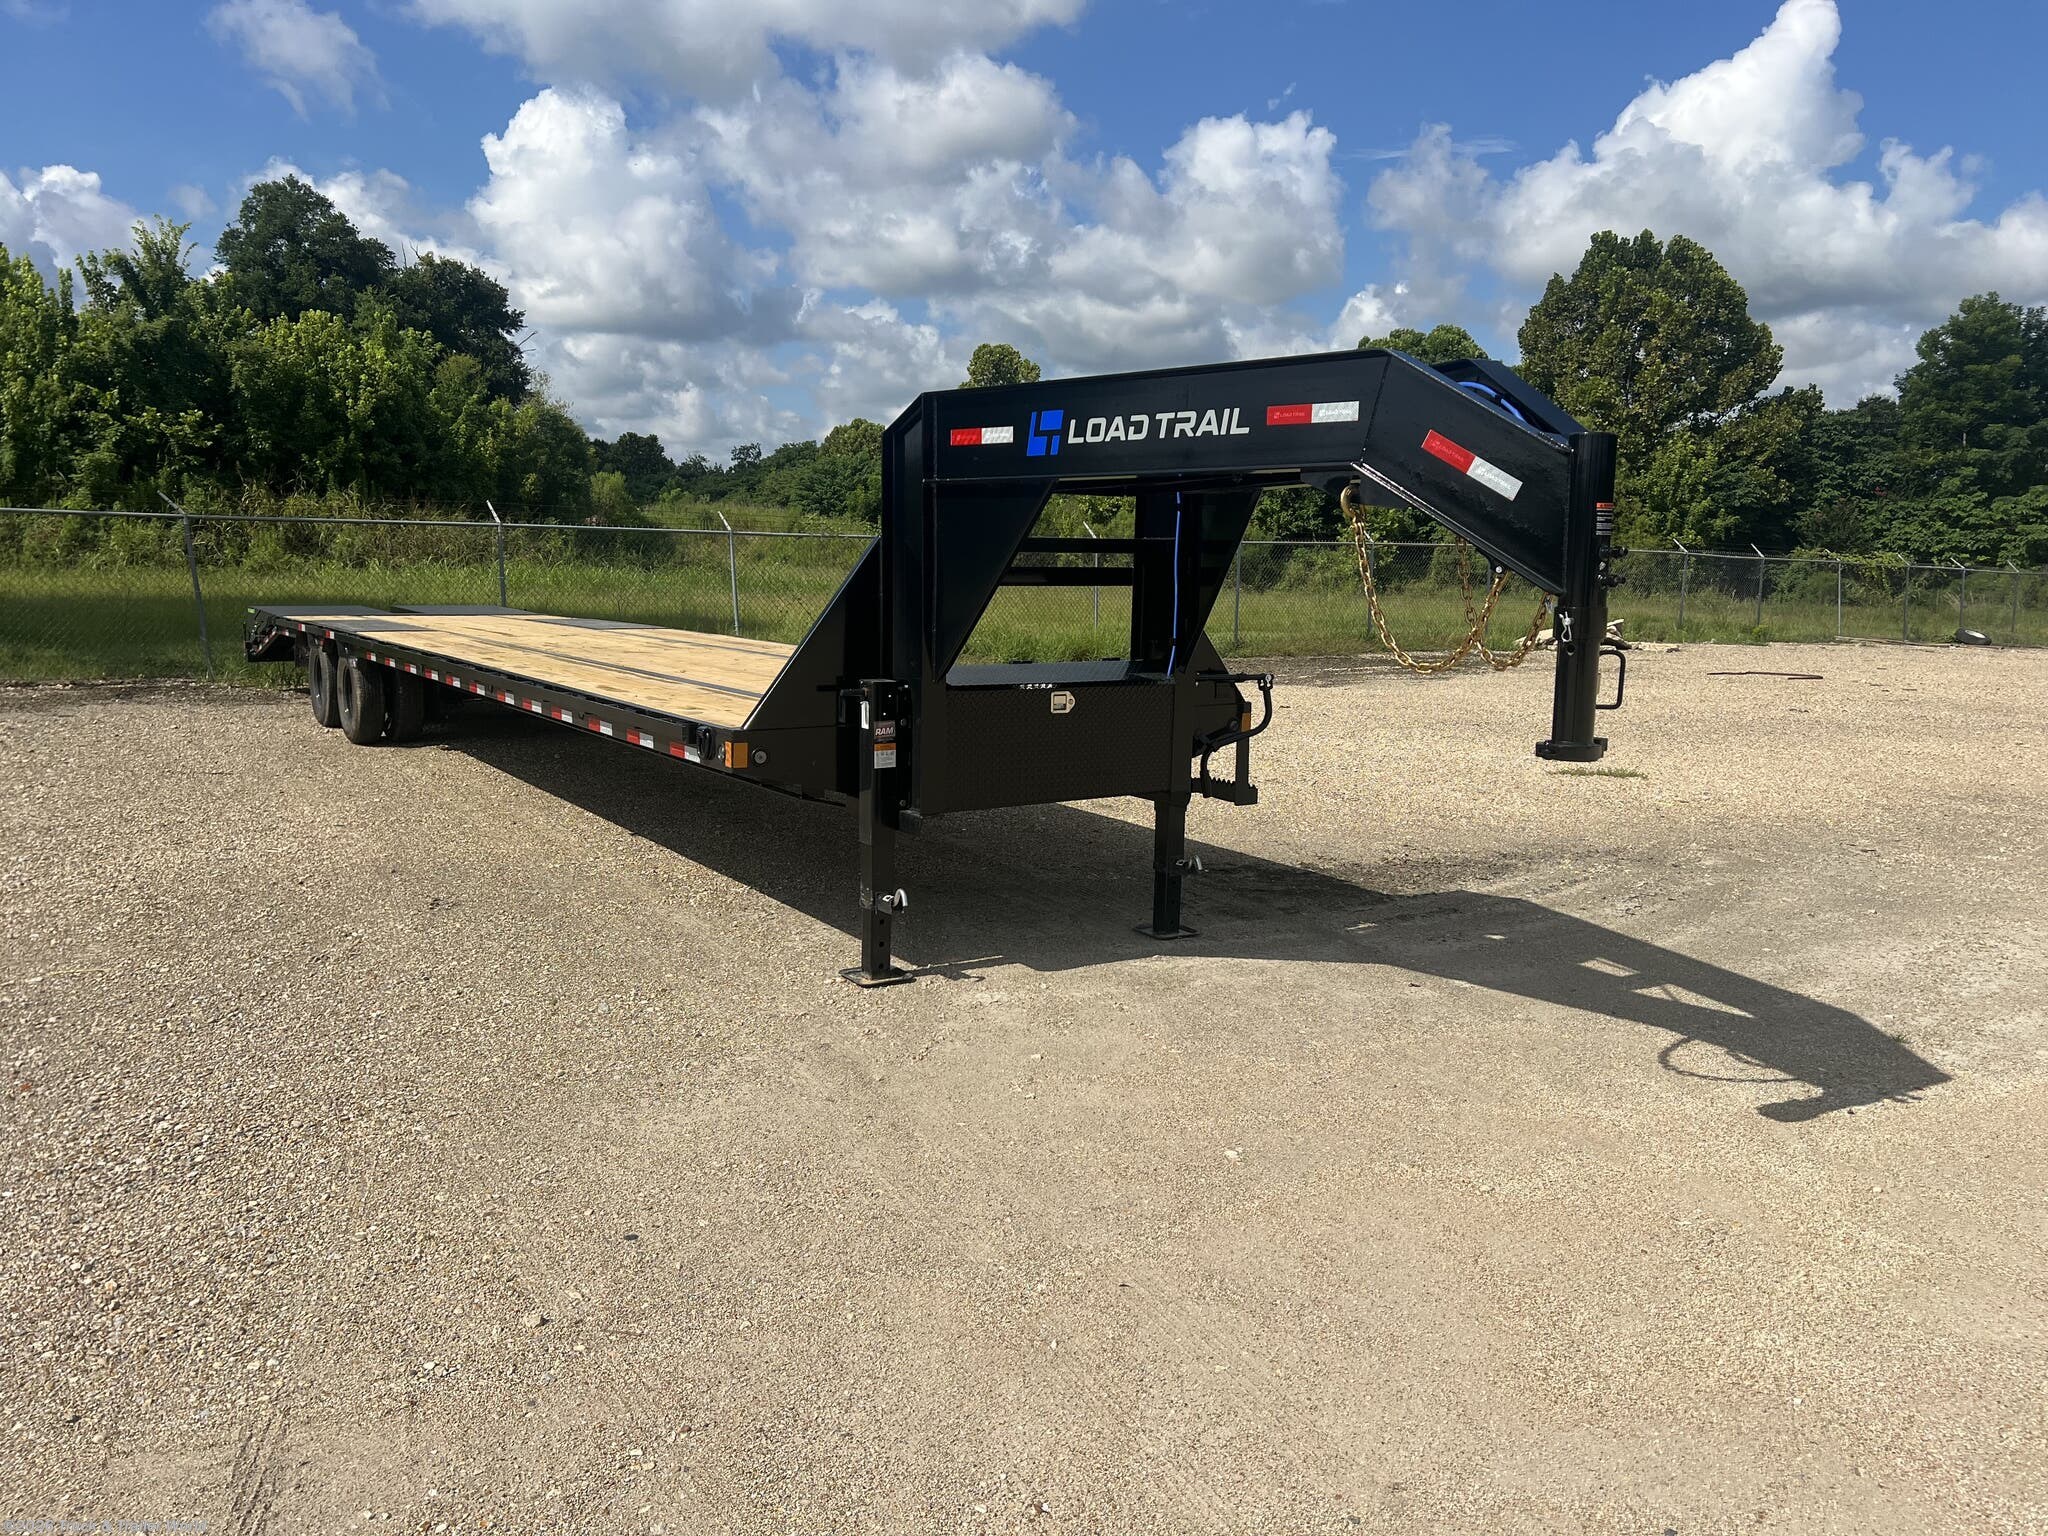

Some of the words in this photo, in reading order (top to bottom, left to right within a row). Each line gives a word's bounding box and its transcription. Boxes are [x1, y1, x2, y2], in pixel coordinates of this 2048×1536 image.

[1067, 414, 1149, 444] LOAD
[1155, 407, 1250, 439] TRAIL
[875, 727, 893, 736] RAM
